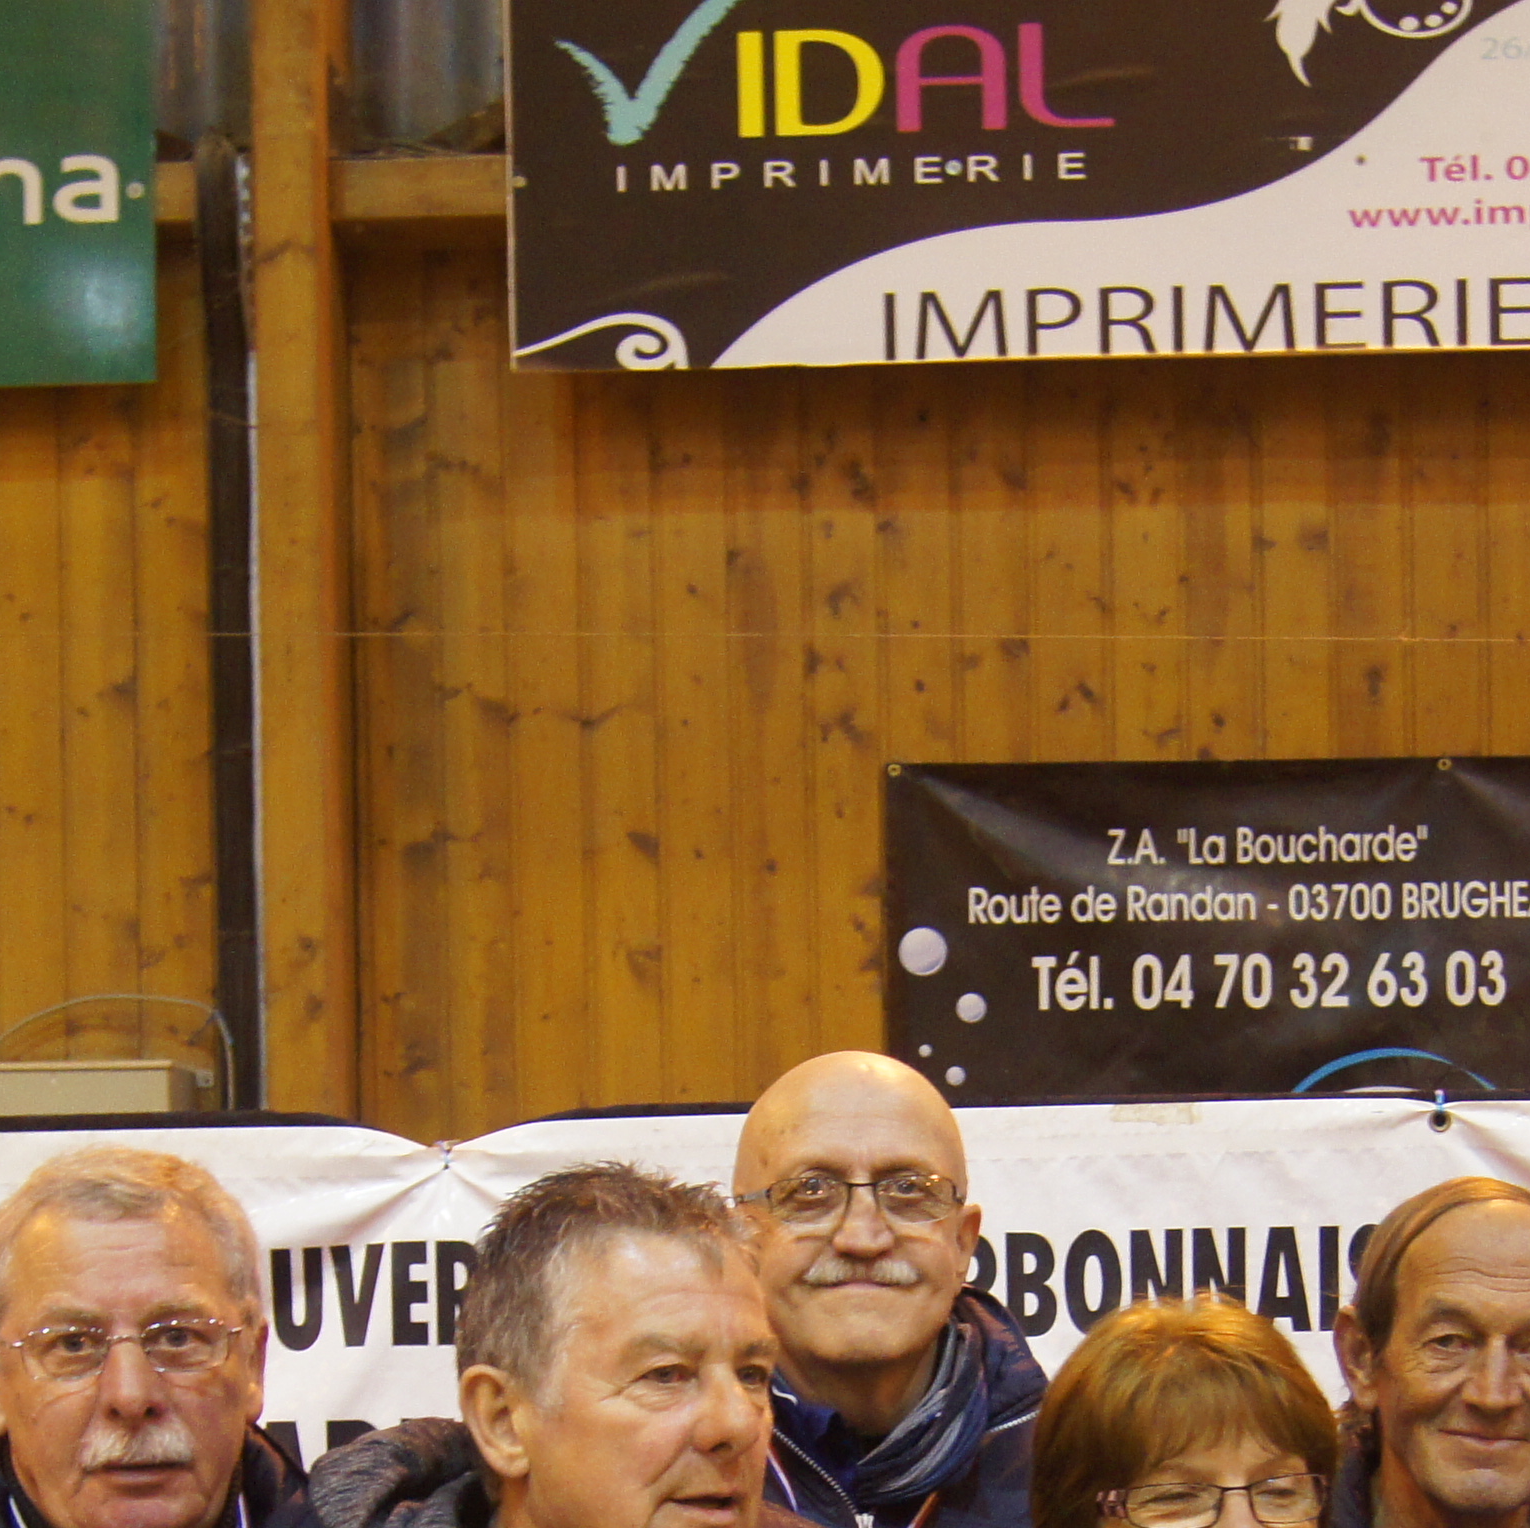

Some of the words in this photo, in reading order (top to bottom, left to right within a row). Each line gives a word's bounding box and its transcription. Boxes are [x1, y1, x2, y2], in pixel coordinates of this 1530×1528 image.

[555, 0, 1116, 147] VIDAL
[615, 152, 1088, 194] IMPRIMERIE
[1418, 151, 1495, 183] Tél.
[1106, 828, 1166, 866] Z.A.
[1177, 827, 1227, 864] "La
[1235, 824, 1429, 864] Boucharde"
[968, 886, 1062, 925] Route
[1070, 885, 1117, 923] de
[1126, 884, 1257, 923] Randan
[1287, 883, 1392, 921] 03700
[1031, 950, 1114, 1012] Tél.
[1131, 953, 1195, 1010] 04
[1213, 952, 1272, 1010] 70
[1289, 952, 1350, 1009] 32
[1366, 951, 1429, 1007] 63
[1444, 949, 1508, 1006] 03
